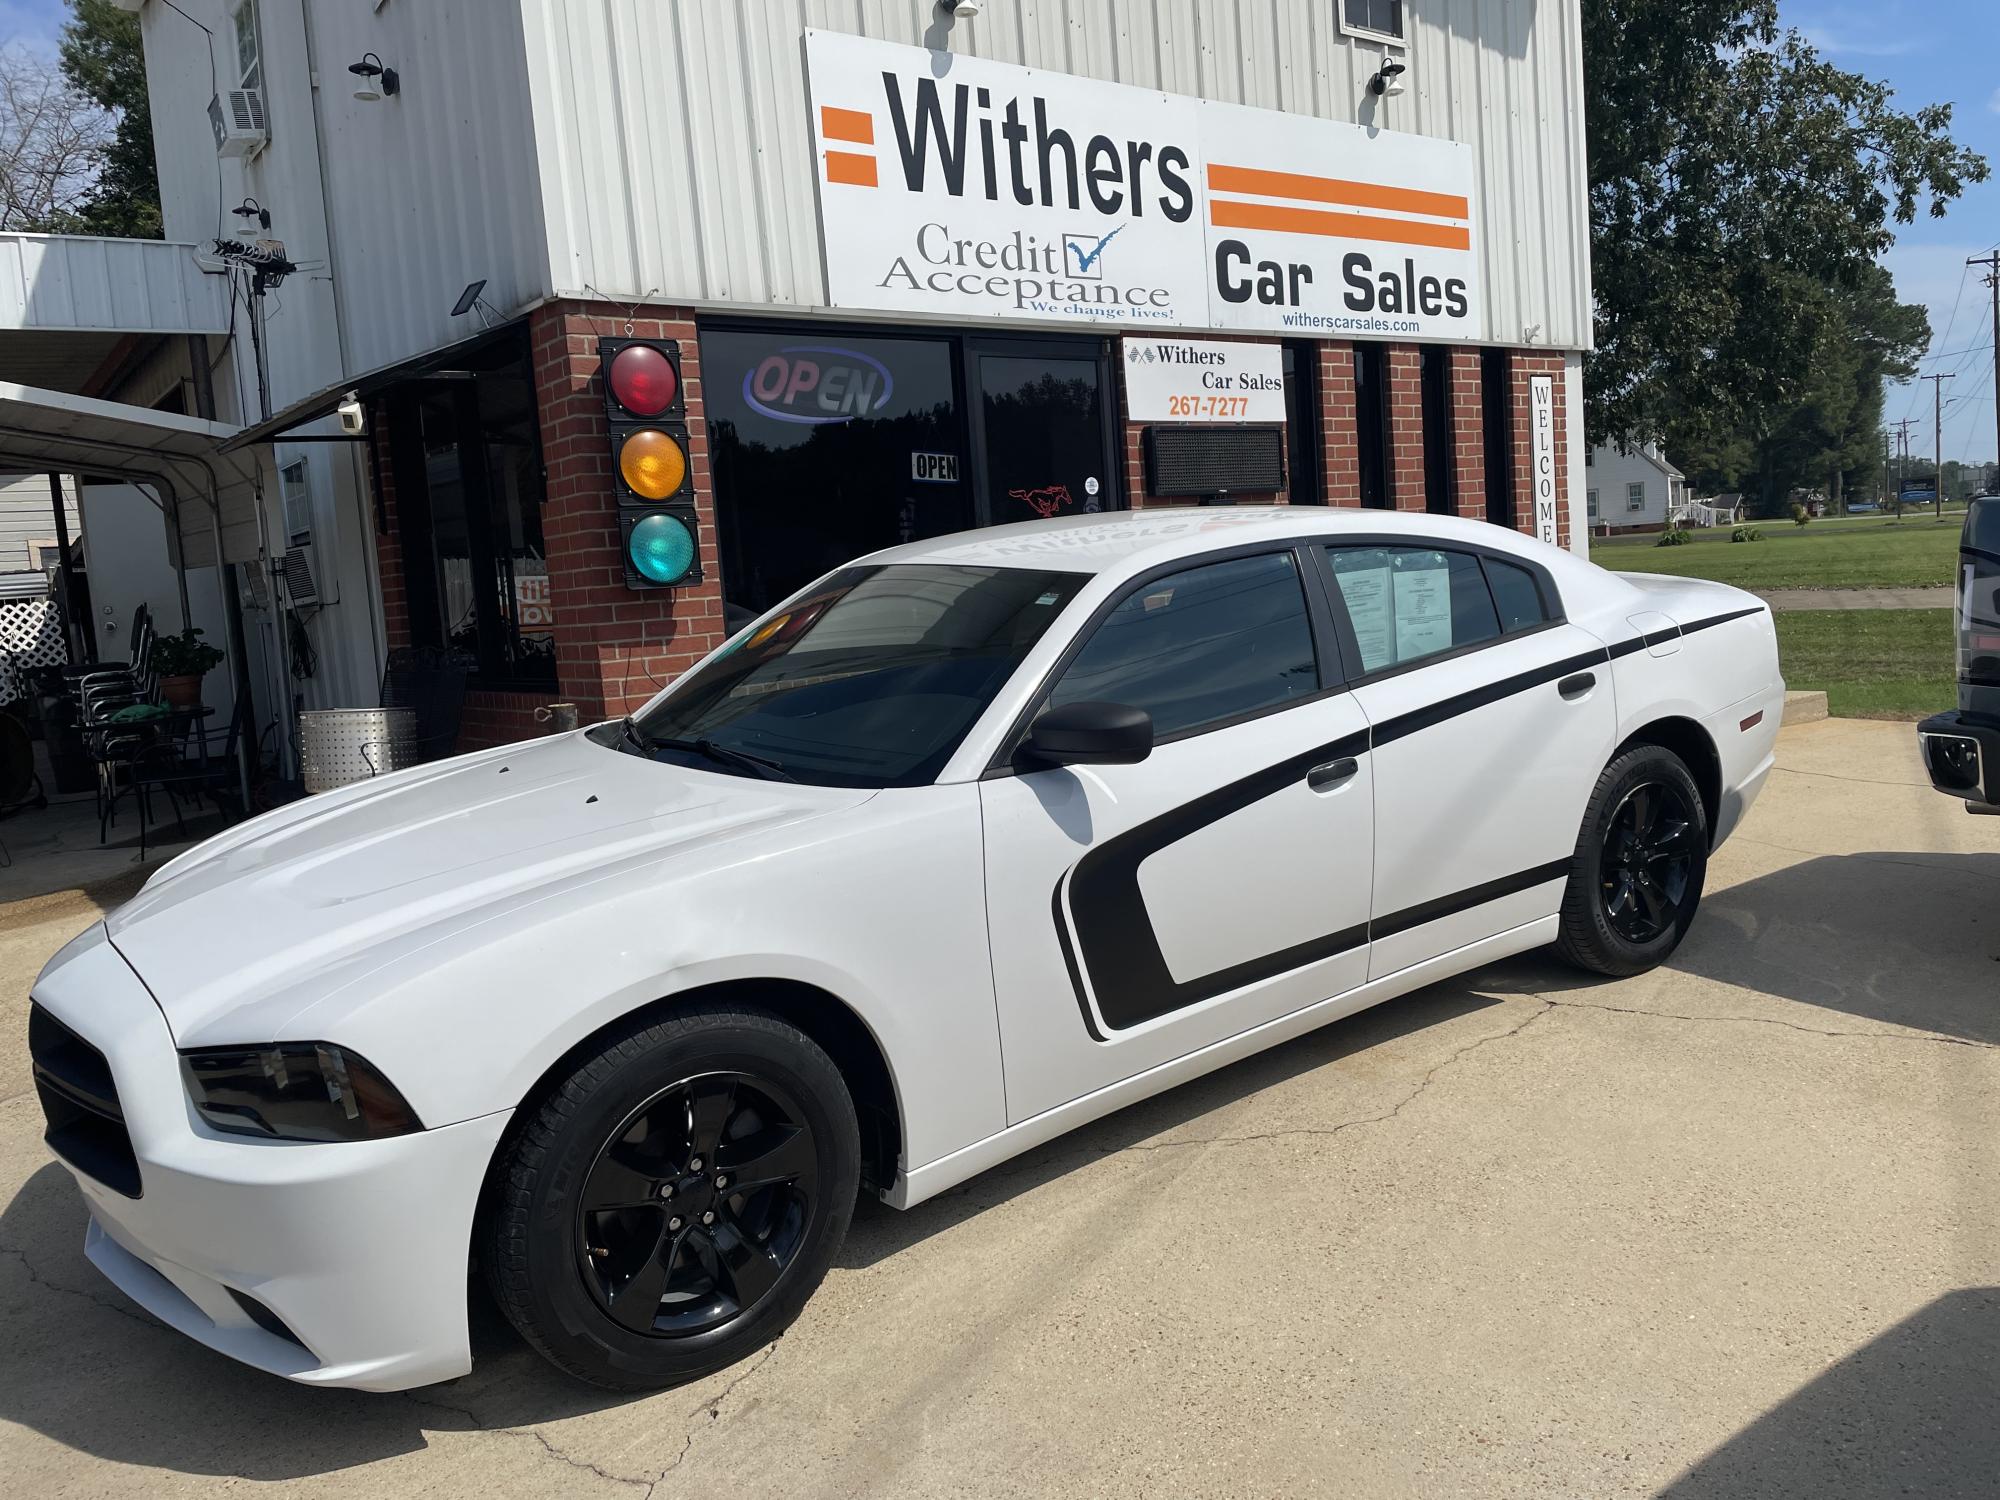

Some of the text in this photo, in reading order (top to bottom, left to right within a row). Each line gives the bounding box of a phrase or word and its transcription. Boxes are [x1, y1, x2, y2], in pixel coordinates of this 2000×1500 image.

[882, 71, 1193, 223] Withers
[916, 223, 1060, 275] Credit
[875, 256, 1170, 310] Acceptance
[1215, 239, 1468, 318] Car Sales
[1029, 300, 1174, 319] We change lives!
[1282, 312, 1420, 332] witherscarsales.com
[1156, 345, 1226, 365] Withers
[753, 356, 878, 416] OPEN
[1202, 371, 1282, 390] Car Sales
[1169, 396, 1249, 416] 267-7277
[916, 454, 958, 480] OPEN
[1534, 386, 1553, 543] WELCOME
